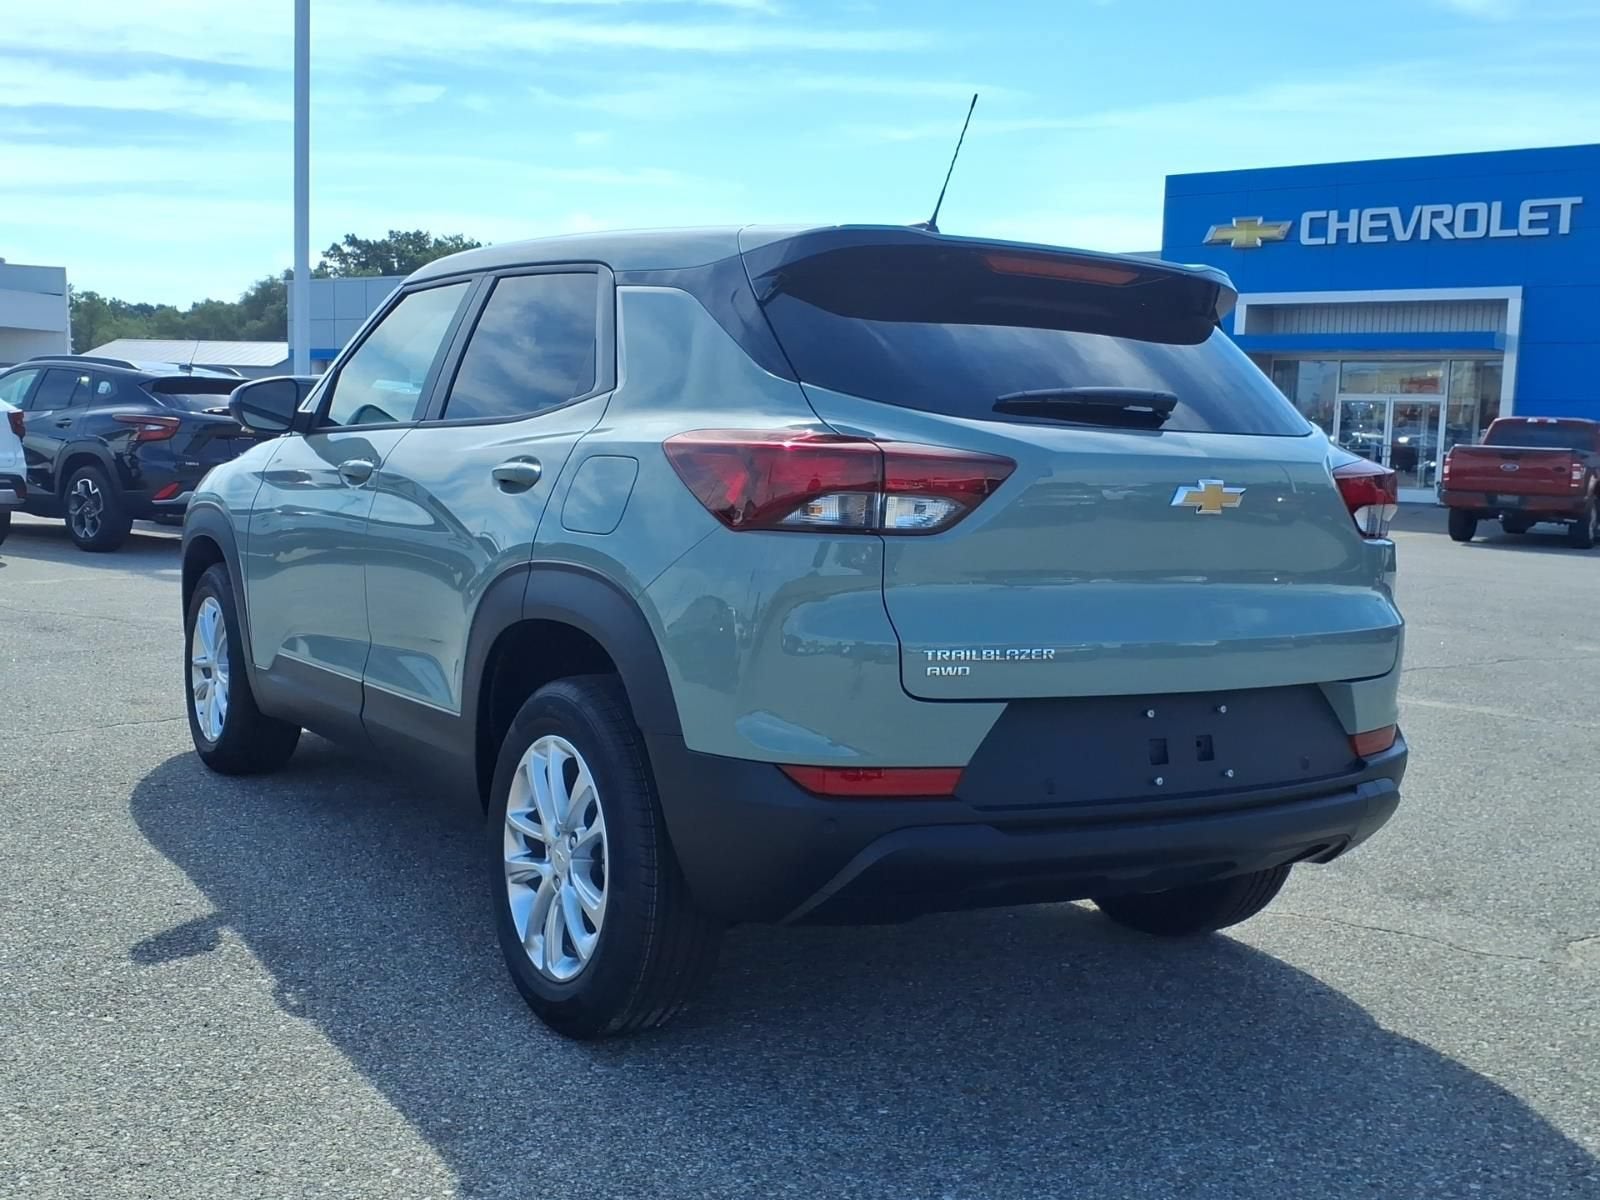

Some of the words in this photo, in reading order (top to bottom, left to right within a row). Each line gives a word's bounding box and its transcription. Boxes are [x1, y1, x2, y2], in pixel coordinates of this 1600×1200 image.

[1300, 196, 1583, 246] CHEVROLET
[924, 648, 1055, 661] TRAILBLAZER
[926, 666, 970, 676] AWD
